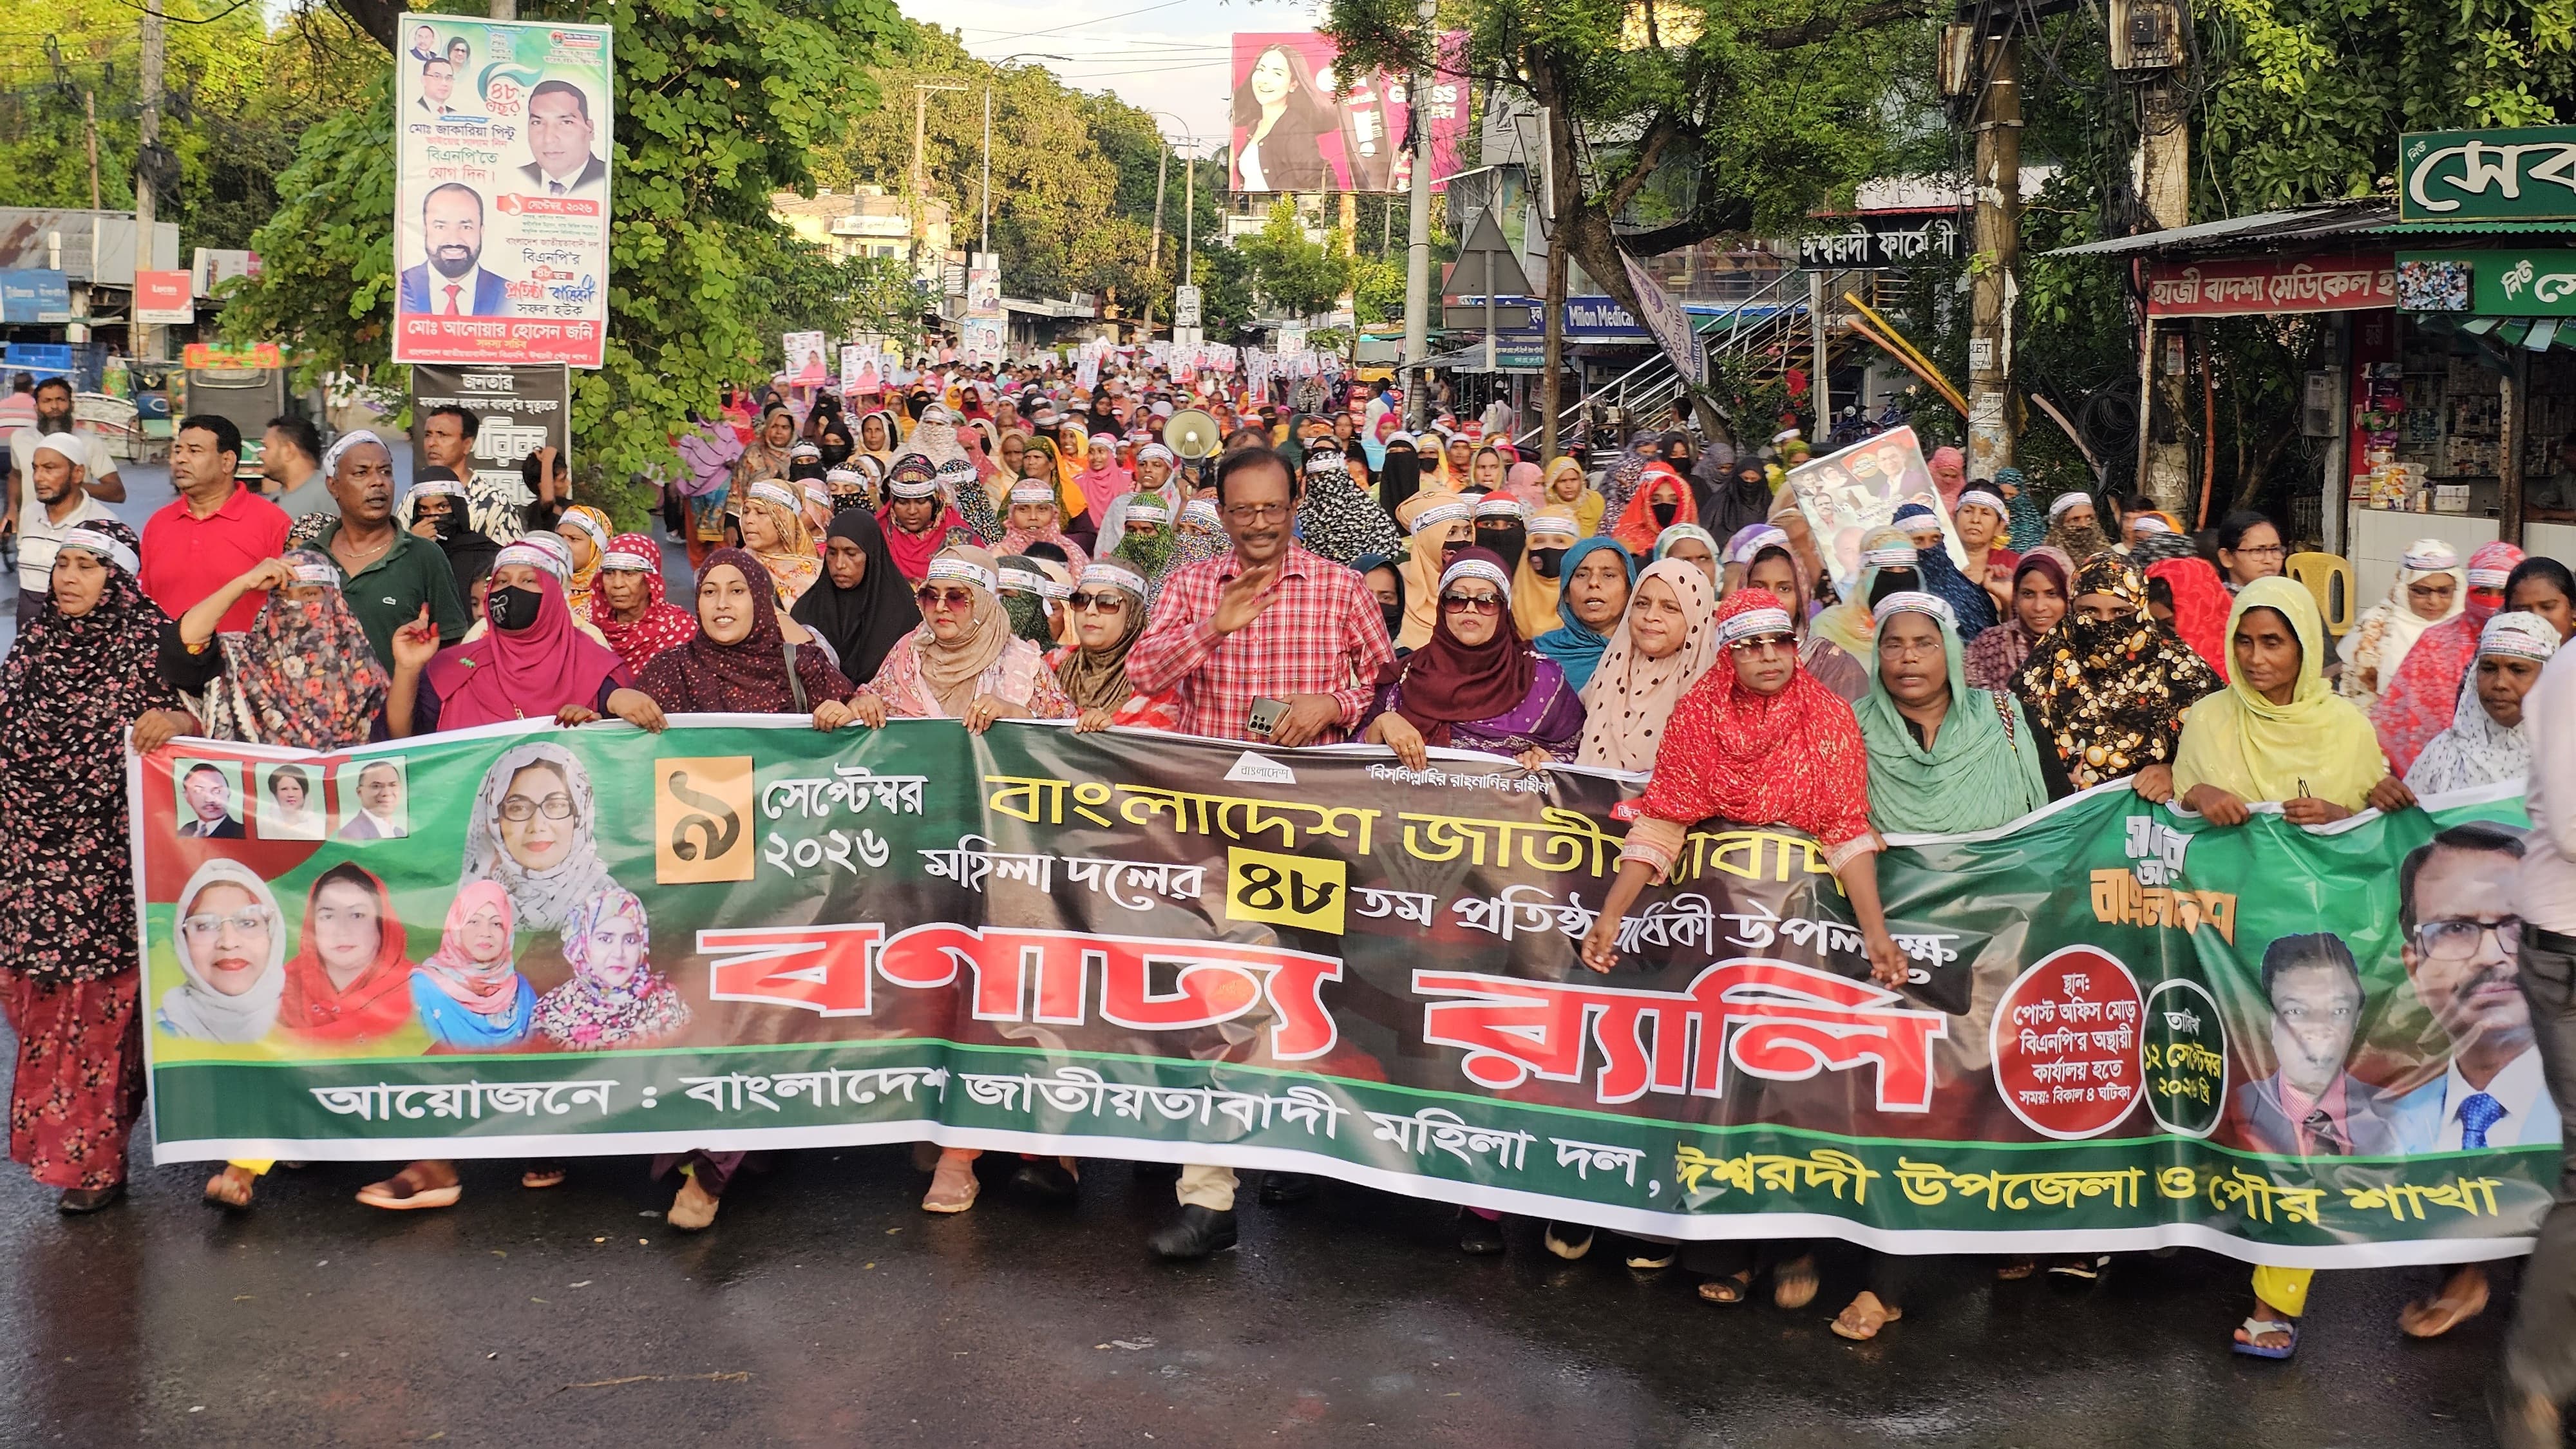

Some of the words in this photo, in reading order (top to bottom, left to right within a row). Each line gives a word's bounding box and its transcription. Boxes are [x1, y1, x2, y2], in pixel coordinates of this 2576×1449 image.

[409, 124, 431, 134] মোঃ
[435, 123, 487, 137] জাকারিয়া
[2407, 140, 2426, 162] নিউ
[429, 167, 457, 180] যোগ
[463, 164, 486, 181] দিন
[566, 203, 593, 213] ২০২৬
[505, 238, 538, 246] বাংলাদেশ
[540, 238, 585, 247] জাতীয়তাবাদী
[1801, 223, 1873, 264] ঈশ্বরদী
[2152, 267, 2201, 305] হাজী
[2204, 276, 2265, 302] বাদশা
[2268, 263, 2373, 306] মেডিকেল
[2501, 260, 2534, 300] নিউ
[516, 304, 549, 315] সফল
[553, 302, 583, 317] হউক
[1568, 305, 1596, 327] Milon
[407, 319, 438, 336] মোঃ
[442, 321, 506, 339] আনোয়ার
[512, 323, 561, 341] হোসেন
[564, 321, 594, 341] জনি
[461, 374, 515, 391] জনতার
[762, 762, 929, 820] সেপ্টেম্বর
[985, 775, 1382, 856] বাংলাদেশ
[764, 828, 891, 878] ২০২৬
[916, 834, 1056, 894] মহিলা
[1061, 855, 1208, 912] দলের
[1235, 862, 1341, 916] ৪৮
[1350, 886, 1438, 927] তম
[2012, 999, 2056, 1025] পোস্ট
[2058, 996, 2102, 1023] অফিস
[2106, 999, 2137, 1023] মোড়
[2091, 1023, 2133, 1055] অস্থায়ী
[2032, 1056, 2088, 1083] কার্যালয়
[2091, 1060, 2124, 1081] হতে
[2145, 1043, 2163, 1070] ১২
[2166, 1039, 2223, 1079] সেপ্টেম্বর
[2052, 1085, 2084, 1104] বিকাল
[2087, 1088, 2094, 1102] ৪
[2098, 1082, 2132, 1100] ঘটিকা
[310, 1079, 620, 1121] আয়োজনে
[678, 1066, 950, 1113] বাংলাদেশ
[958, 1066, 1350, 1140] জাতীয়তাবাদী
[1365, 1108, 1538, 1171] মহিলা
[1674, 1140, 1881, 1206] ঈশ্বরদী
[1893, 1156, 2146, 1213] উপজেলা
[2155, 1164, 2197, 1198] ও
[2208, 1166, 2326, 1226] পৌর
[2345, 1176, 2505, 1222] শাখা
